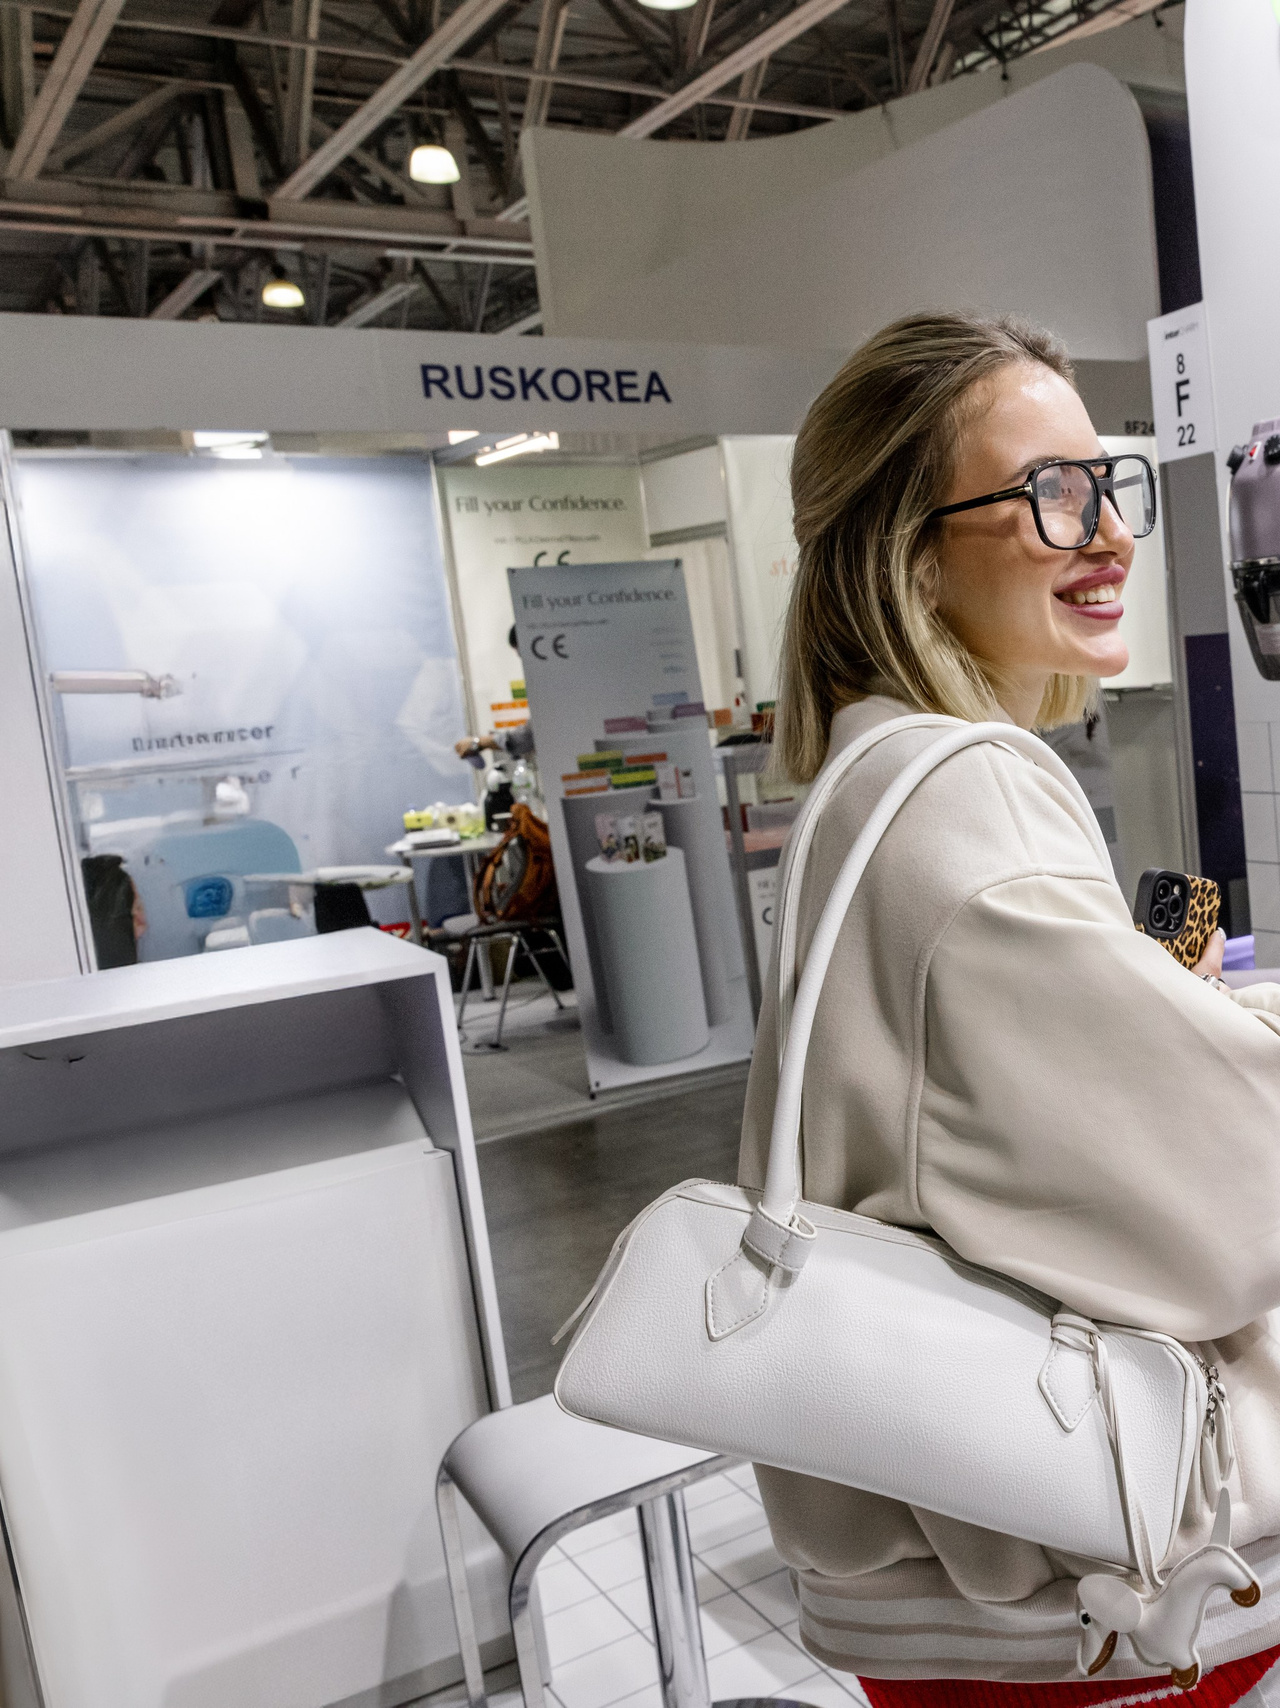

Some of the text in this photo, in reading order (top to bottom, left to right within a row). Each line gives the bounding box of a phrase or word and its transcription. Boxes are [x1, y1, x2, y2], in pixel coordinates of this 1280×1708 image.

[1176, 353, 1186, 375] 8
[420, 363, 672, 403] RUSKOREA
[1175, 379, 1190, 417] F
[1177, 423, 1196, 447] 22
[455, 496, 479, 513] Fill
[483, 500, 523, 517] your
[522, 593, 544, 609] Fill
[546, 594, 582, 611] your
